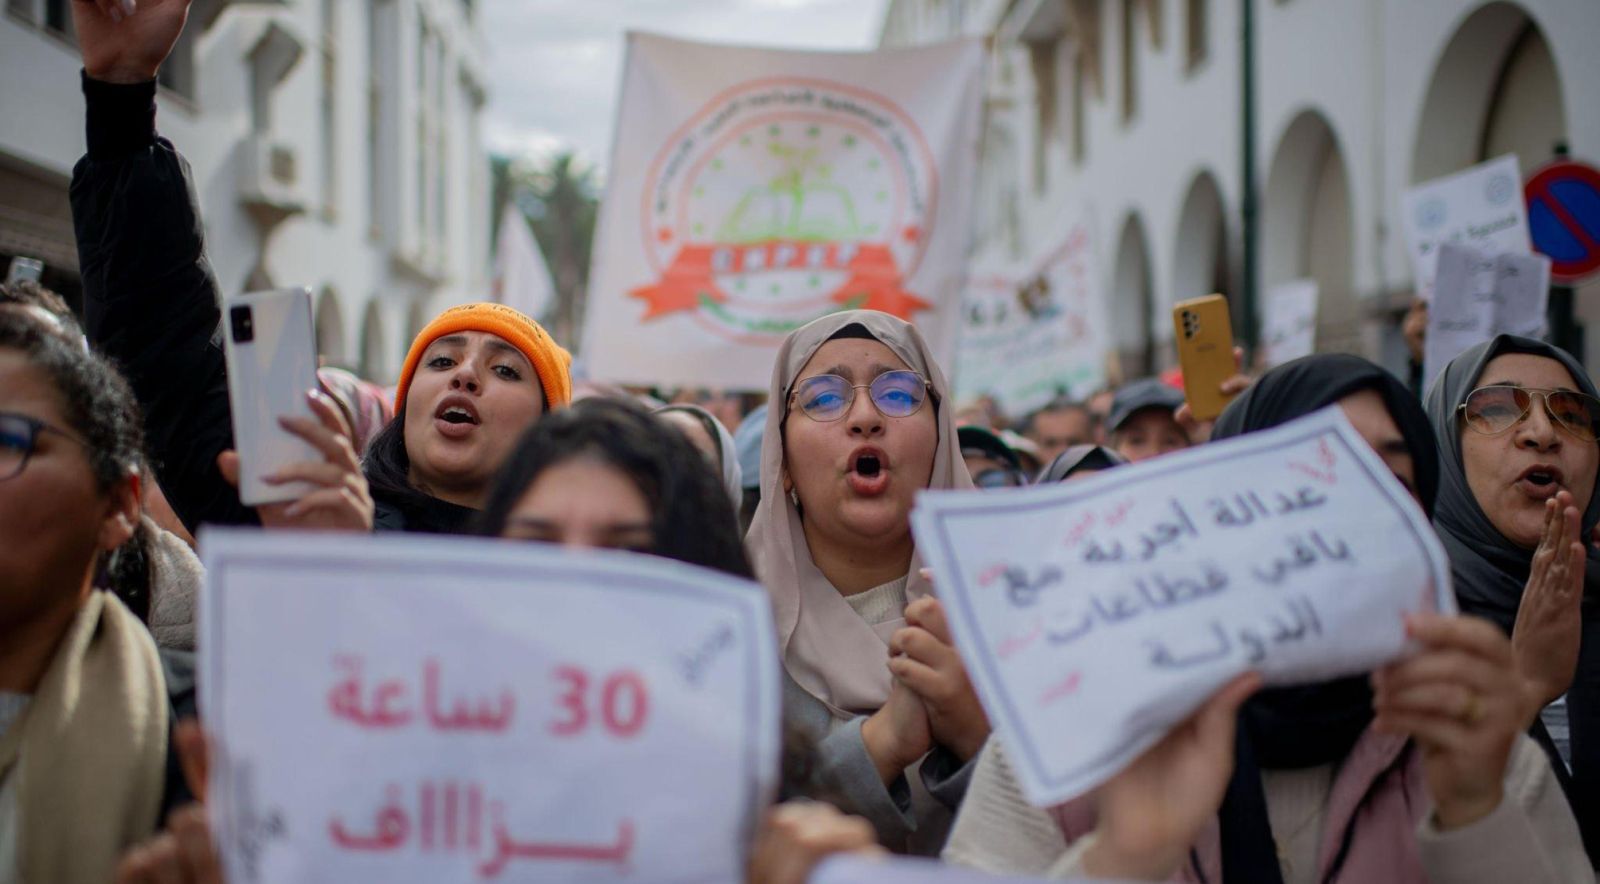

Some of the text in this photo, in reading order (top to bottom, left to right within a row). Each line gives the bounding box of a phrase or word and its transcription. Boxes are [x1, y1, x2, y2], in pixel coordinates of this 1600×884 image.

[1206, 487, 1327, 527] عدالة
[1002, 565, 1063, 608] مع
[328, 653, 651, 737] 30 ساعة
